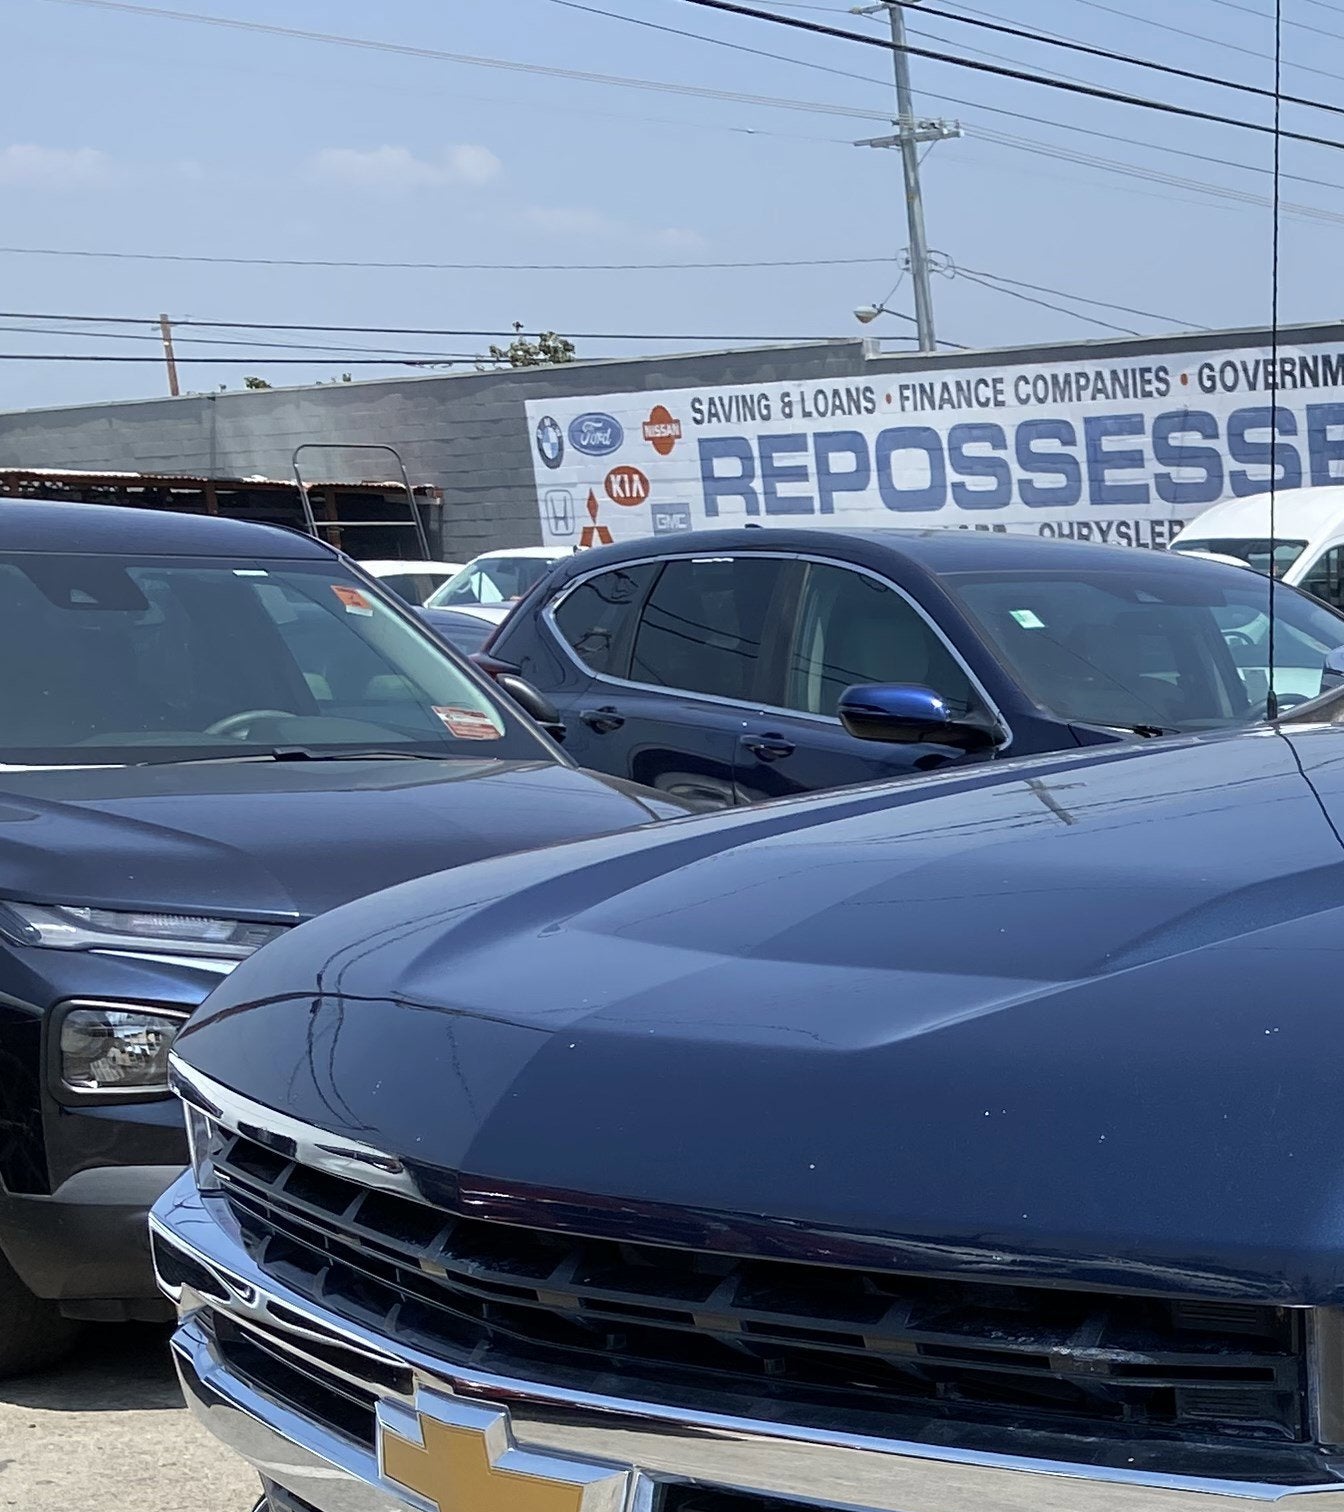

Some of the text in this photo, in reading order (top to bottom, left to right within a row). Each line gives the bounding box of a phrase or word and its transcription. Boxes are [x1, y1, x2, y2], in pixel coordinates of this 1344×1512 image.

[691, 391, 771, 425] SAVING
[780, 390, 794, 419] &
[801, 385, 877, 419] LOANS
[899, 376, 1007, 412] FINANCE
[1013, 365, 1171, 406] COMPANIES
[580, 421, 612, 446] Ford
[644, 424, 681, 439] NISSAN
[610, 473, 646, 498] KIA
[655, 513, 688, 529] GMC
